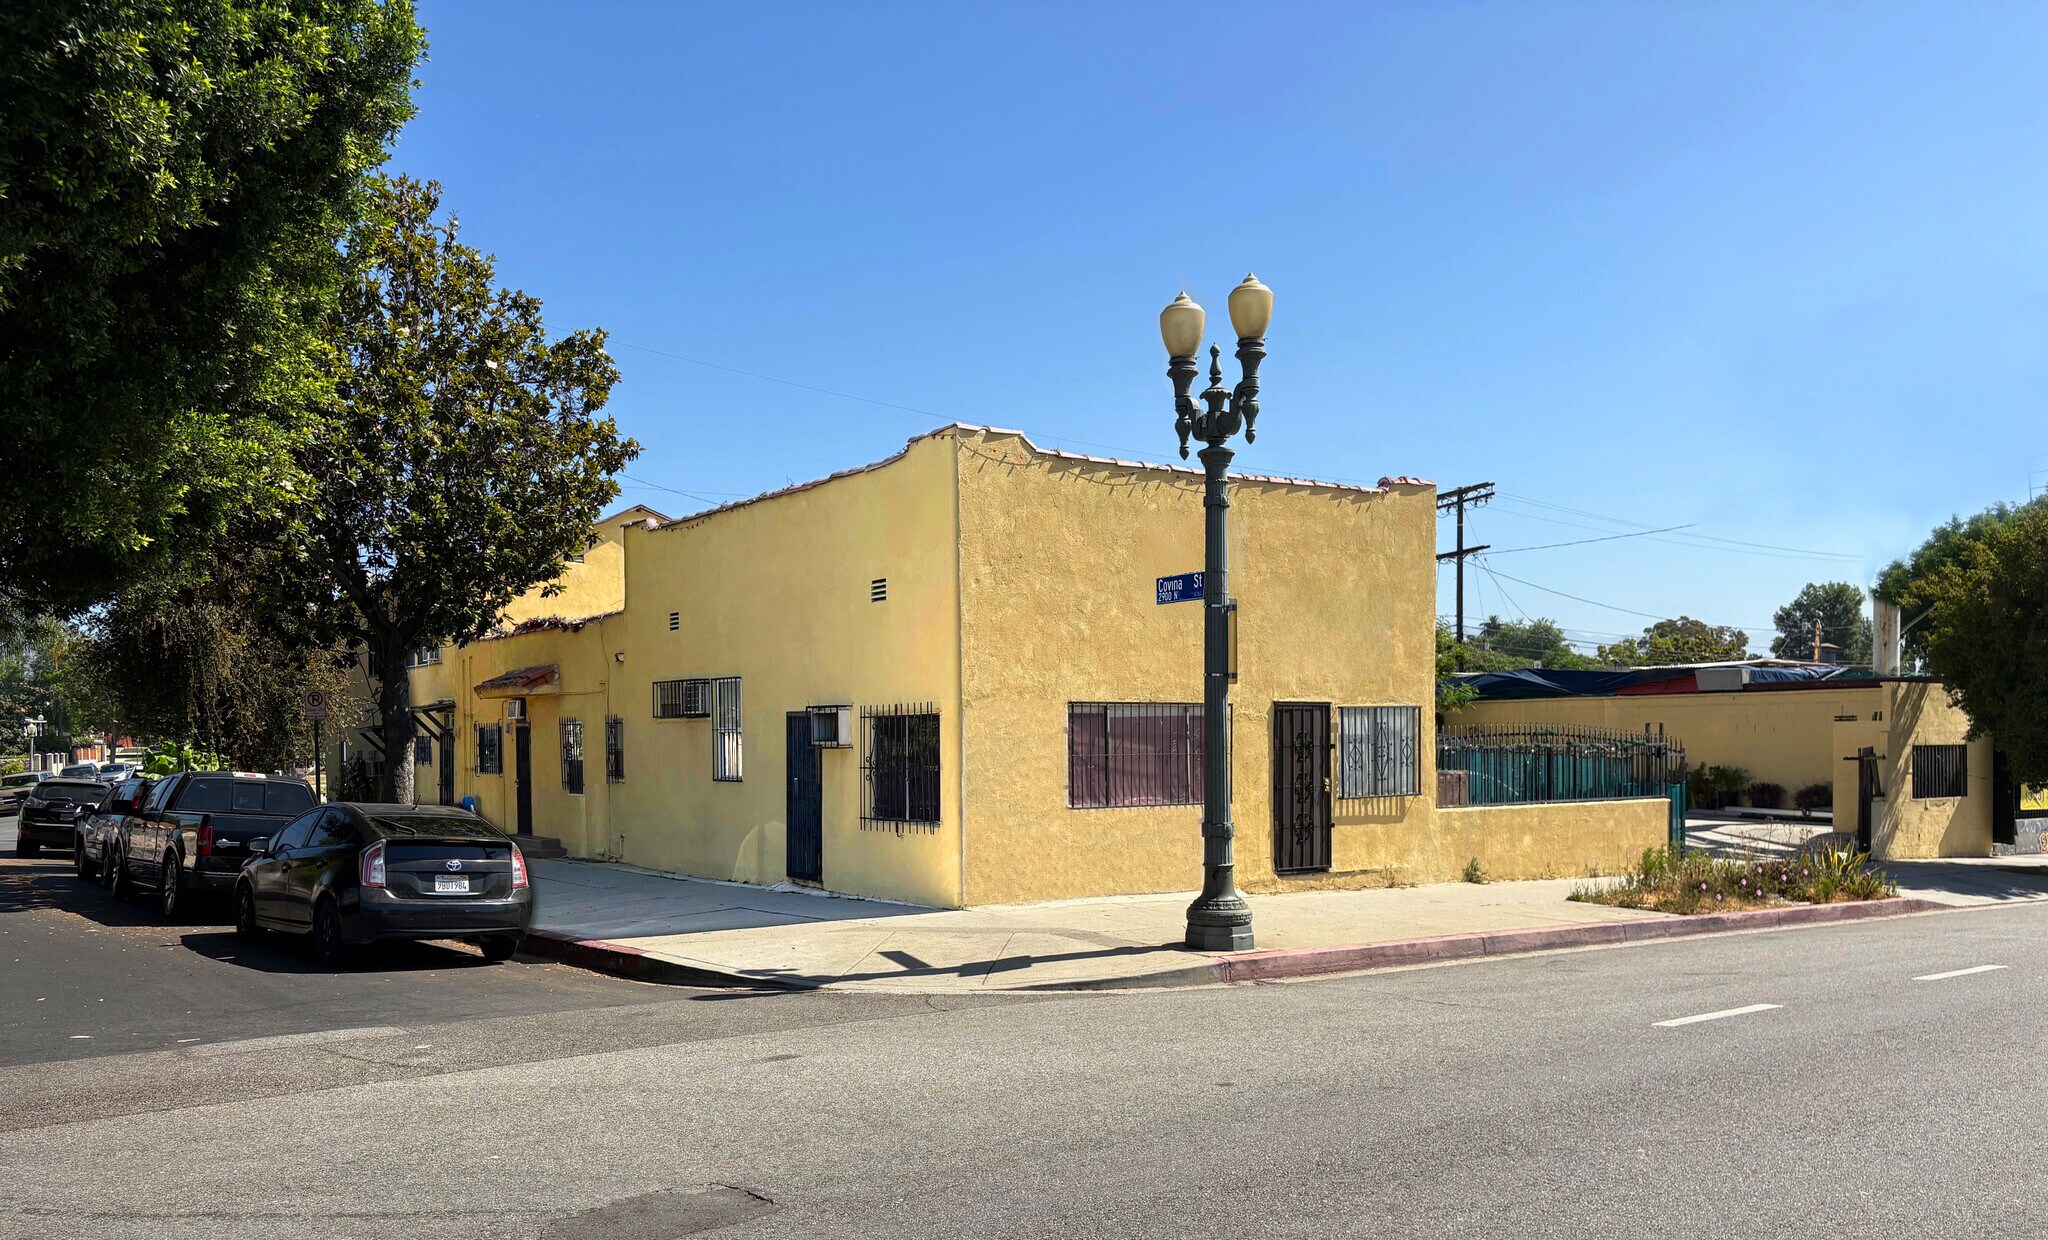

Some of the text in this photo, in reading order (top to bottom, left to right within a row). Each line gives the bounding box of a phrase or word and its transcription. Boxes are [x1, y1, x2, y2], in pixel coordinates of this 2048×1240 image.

[1158, 574, 1203, 592] Covina St
[1158, 591, 1173, 602] 2900
